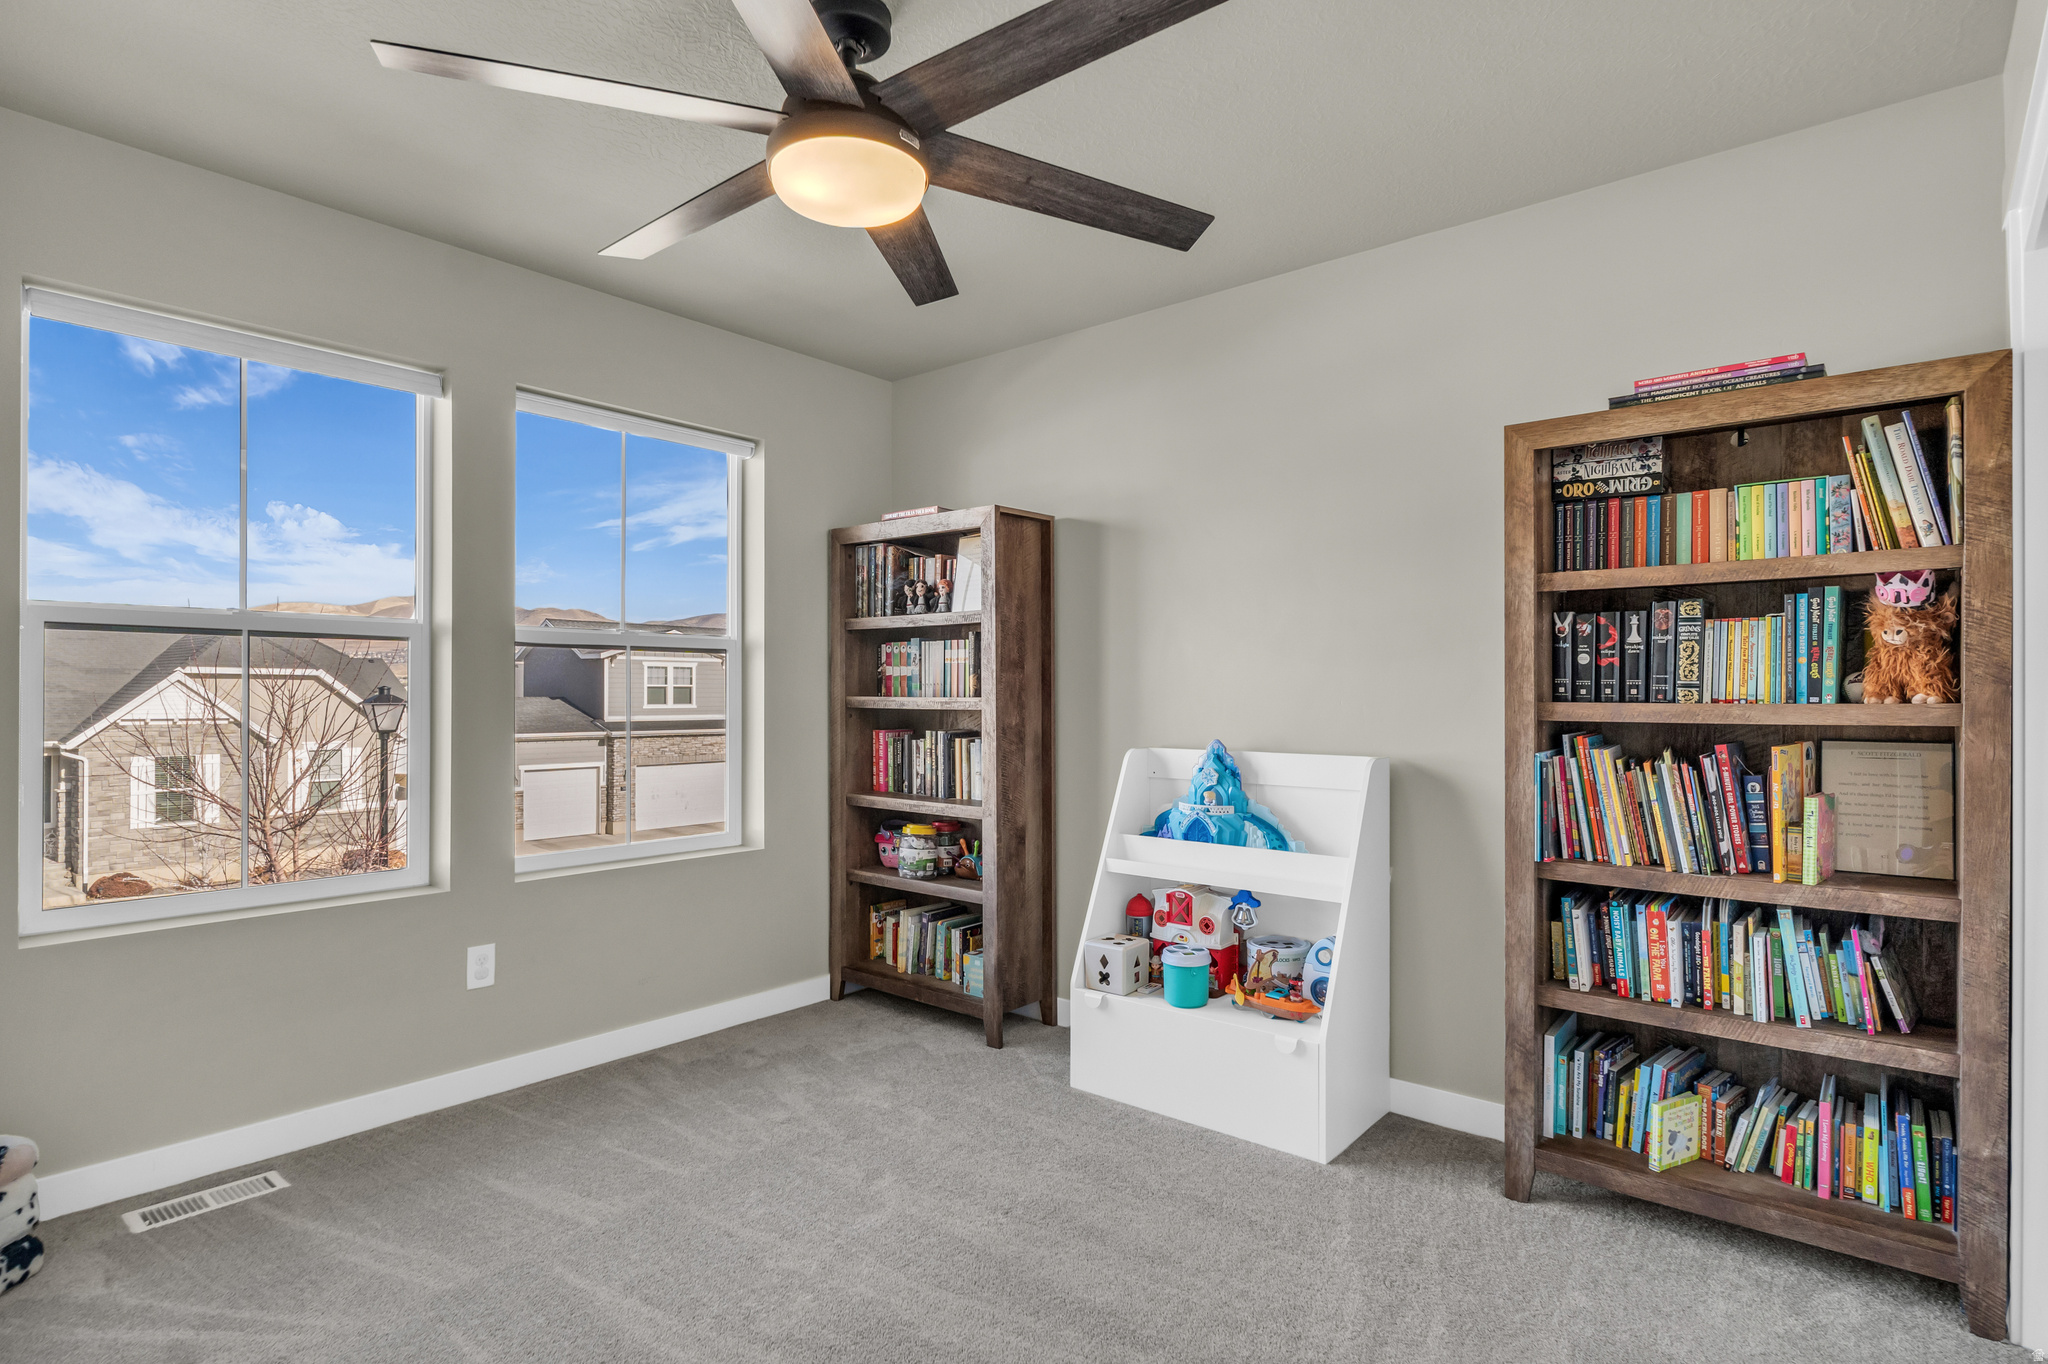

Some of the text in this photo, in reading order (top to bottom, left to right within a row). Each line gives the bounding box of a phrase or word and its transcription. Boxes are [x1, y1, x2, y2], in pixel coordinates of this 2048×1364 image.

[1690, 368, 1719, 376] ANIMALS
[1707, 372, 1732, 381] ANIMALS
[1650, 386, 1690, 396] MAGNIFICENT
[1722, 376, 1744, 385] OCEAN
[1745, 371, 1781, 382] CREATURES
[1654, 390, 1700, 402] MAGNIFICENT
[1702, 386, 1722, 395] BOOK
[1736, 380, 1768, 390] ANIMALS
[1584, 460, 1637, 478] NIGHTBANE
[1893, 427, 1926, 516] THE ROALD DAHL TREASURY
[1562, 482, 1595, 498] ORO
[1608, 476, 1653, 494] GRIM
[1875, 586, 1928, 604] one
[1811, 647, 1820, 662] REBEL
[1825, 646, 1834, 662] REBEL
[1810, 662, 1820, 678] GIRLS
[1825, 662, 1834, 678] GIRLS
[1722, 767, 1742, 845] 5-MINUTE GIRL POWER STORIES
[1616, 947, 1625, 976] ANIMALS
[1650, 928, 1662, 981] ON THE FARM
[1821, 1133, 1828, 1142] My
[1785, 1142, 1795, 1167] Corduroy
[1917, 1161, 1927, 1184] tiger!
